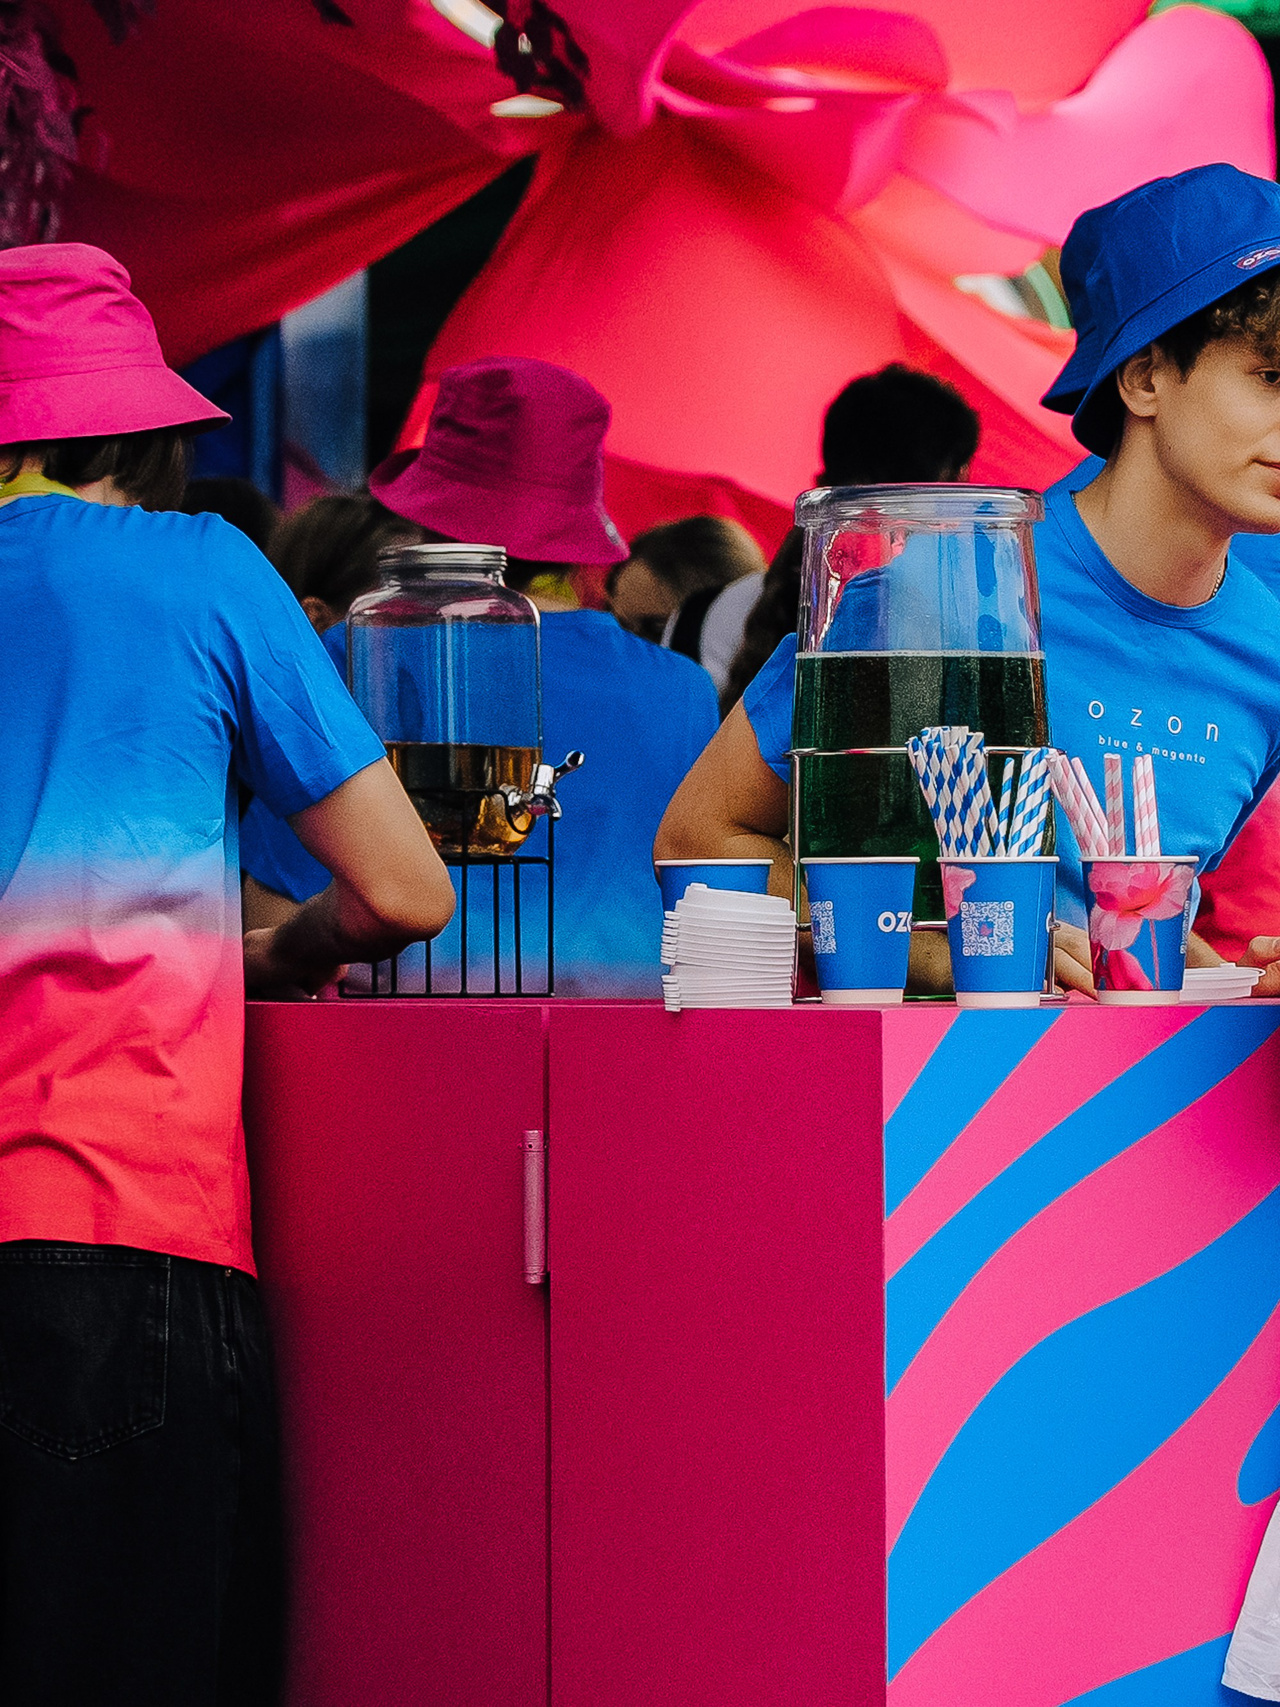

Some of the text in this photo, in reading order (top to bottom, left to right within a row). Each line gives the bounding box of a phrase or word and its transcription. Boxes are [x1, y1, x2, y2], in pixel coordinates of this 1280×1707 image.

[1098, 735, 1206, 765] blue & magenta
